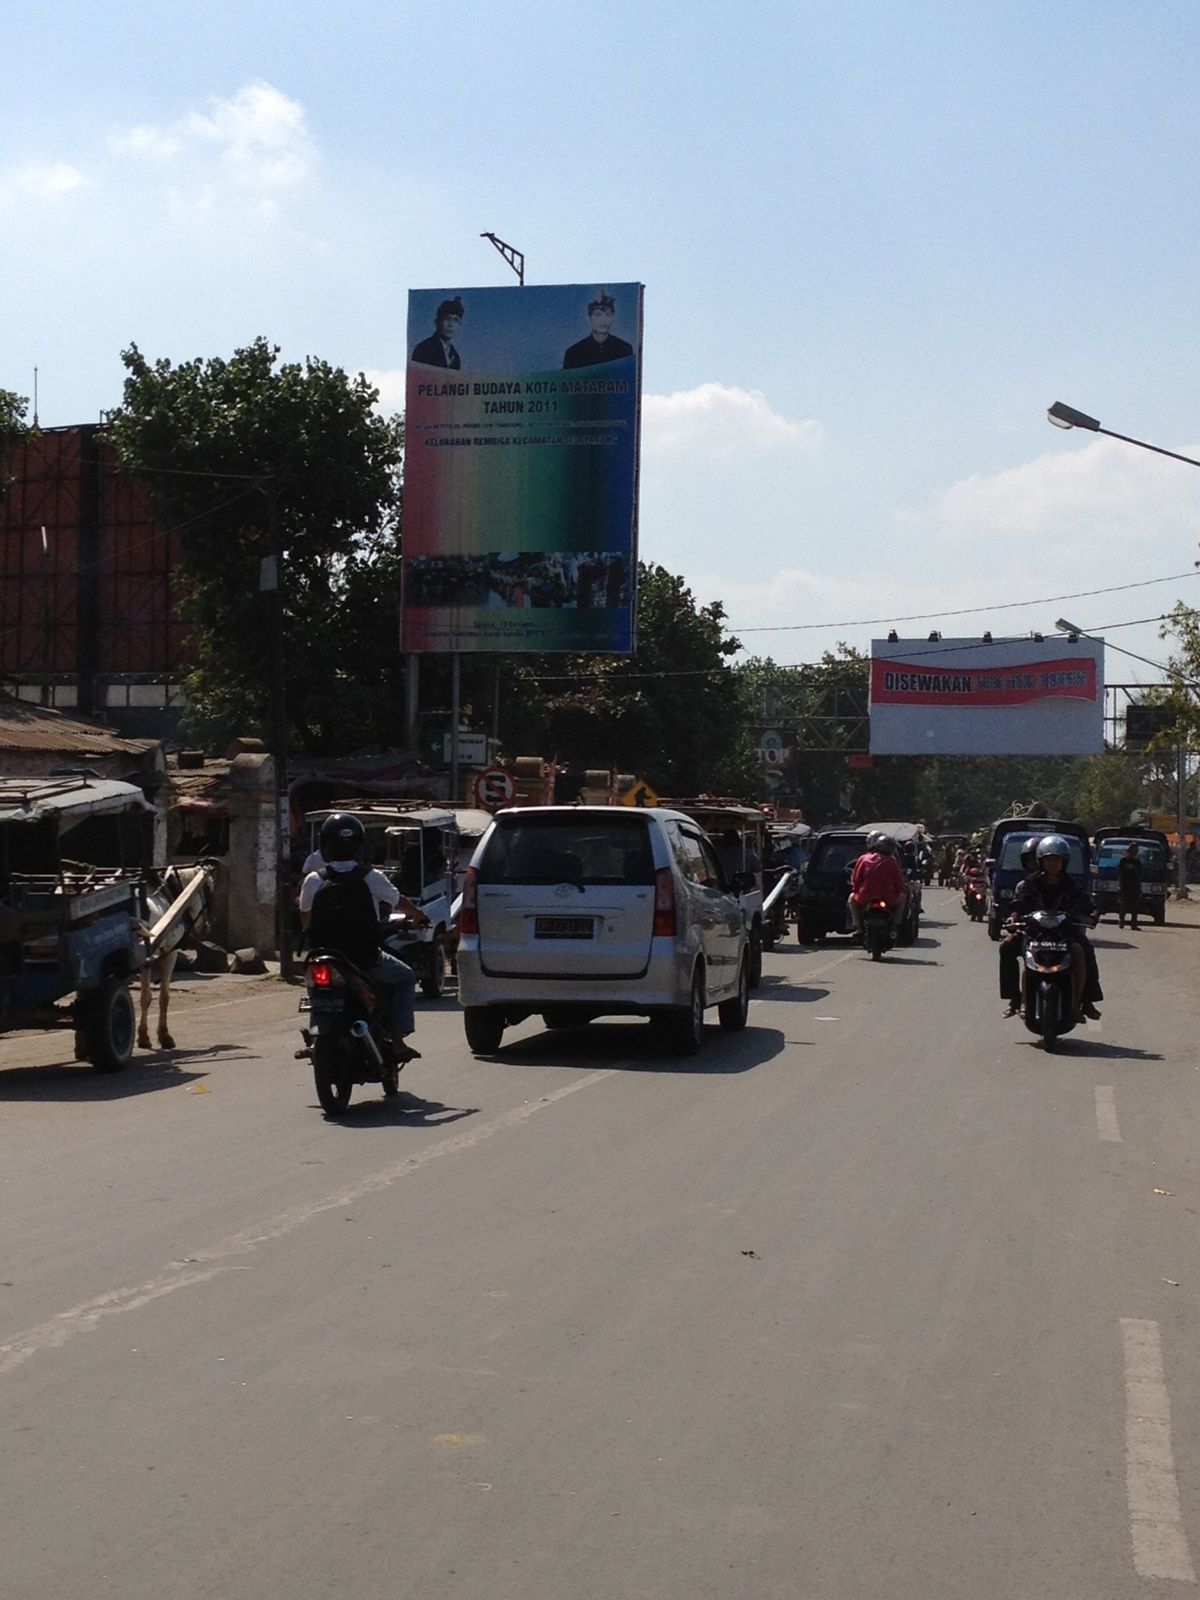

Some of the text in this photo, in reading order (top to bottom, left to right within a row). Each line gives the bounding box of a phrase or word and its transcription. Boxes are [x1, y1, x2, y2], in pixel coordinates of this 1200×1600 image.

[418, 379, 628, 397] PELANGI BUDAYA KOTA MATARAM
[483, 400, 558, 414] TAHUN 2011
[885, 672, 972, 693] DISEWAKAN
[754, 747, 790, 764] TOP
